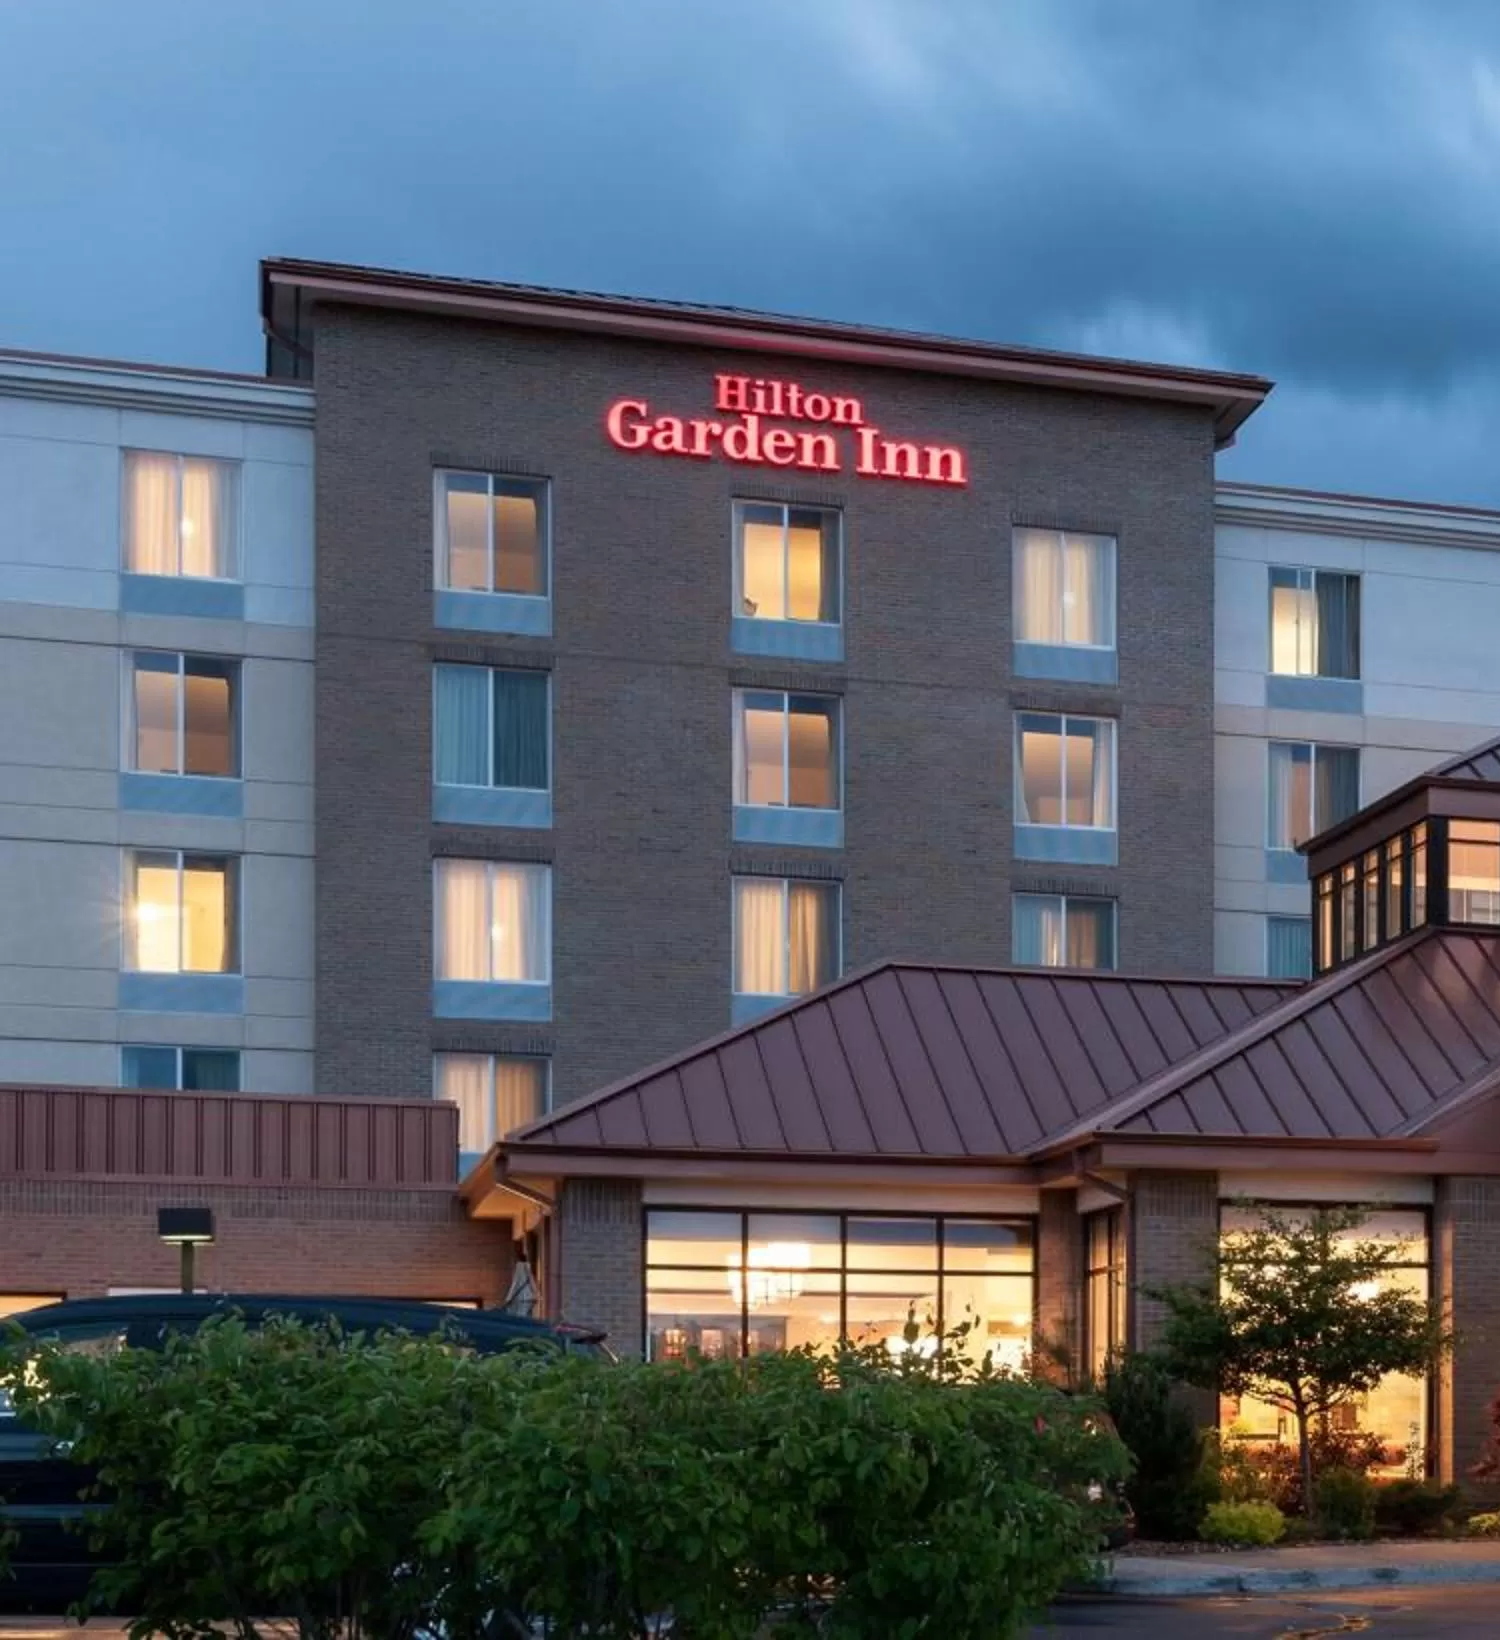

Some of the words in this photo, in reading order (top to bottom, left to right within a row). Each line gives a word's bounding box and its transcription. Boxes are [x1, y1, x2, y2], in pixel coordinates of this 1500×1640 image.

[714, 374, 864, 425] Hilton
[606, 399, 841, 470] Garden
[855, 426, 968, 484] Inn
